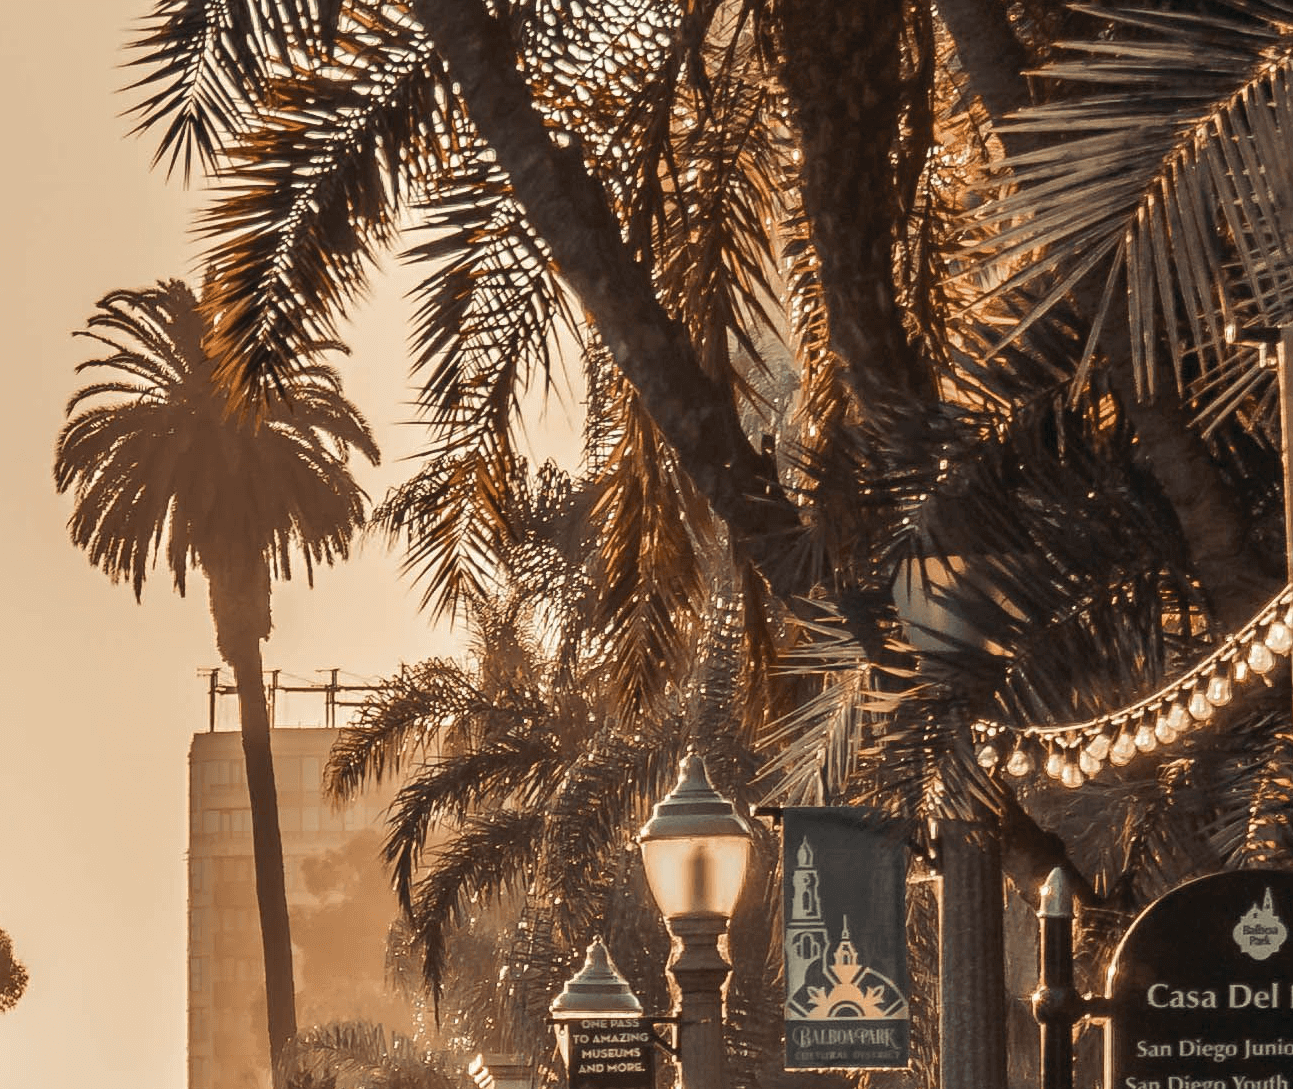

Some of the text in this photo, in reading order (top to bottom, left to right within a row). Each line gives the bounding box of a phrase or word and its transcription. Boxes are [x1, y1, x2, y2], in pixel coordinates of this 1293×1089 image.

[1249, 935, 1272, 946] Park
[1147, 983, 1217, 1009] Casa
[1229, 982, 1279, 1009] Del
[581, 1018, 640, 1029] ONE PASS
[572, 1032, 649, 1044] TO AMAZING
[792, 1025, 902, 1050] BALBOA PARK
[581, 1047, 642, 1059] MUSEUMS
[1137, 1040, 1172, 1058] San
[1179, 1038, 1238, 1063] Diego
[578, 1062, 646, 1074] AND MORE.
